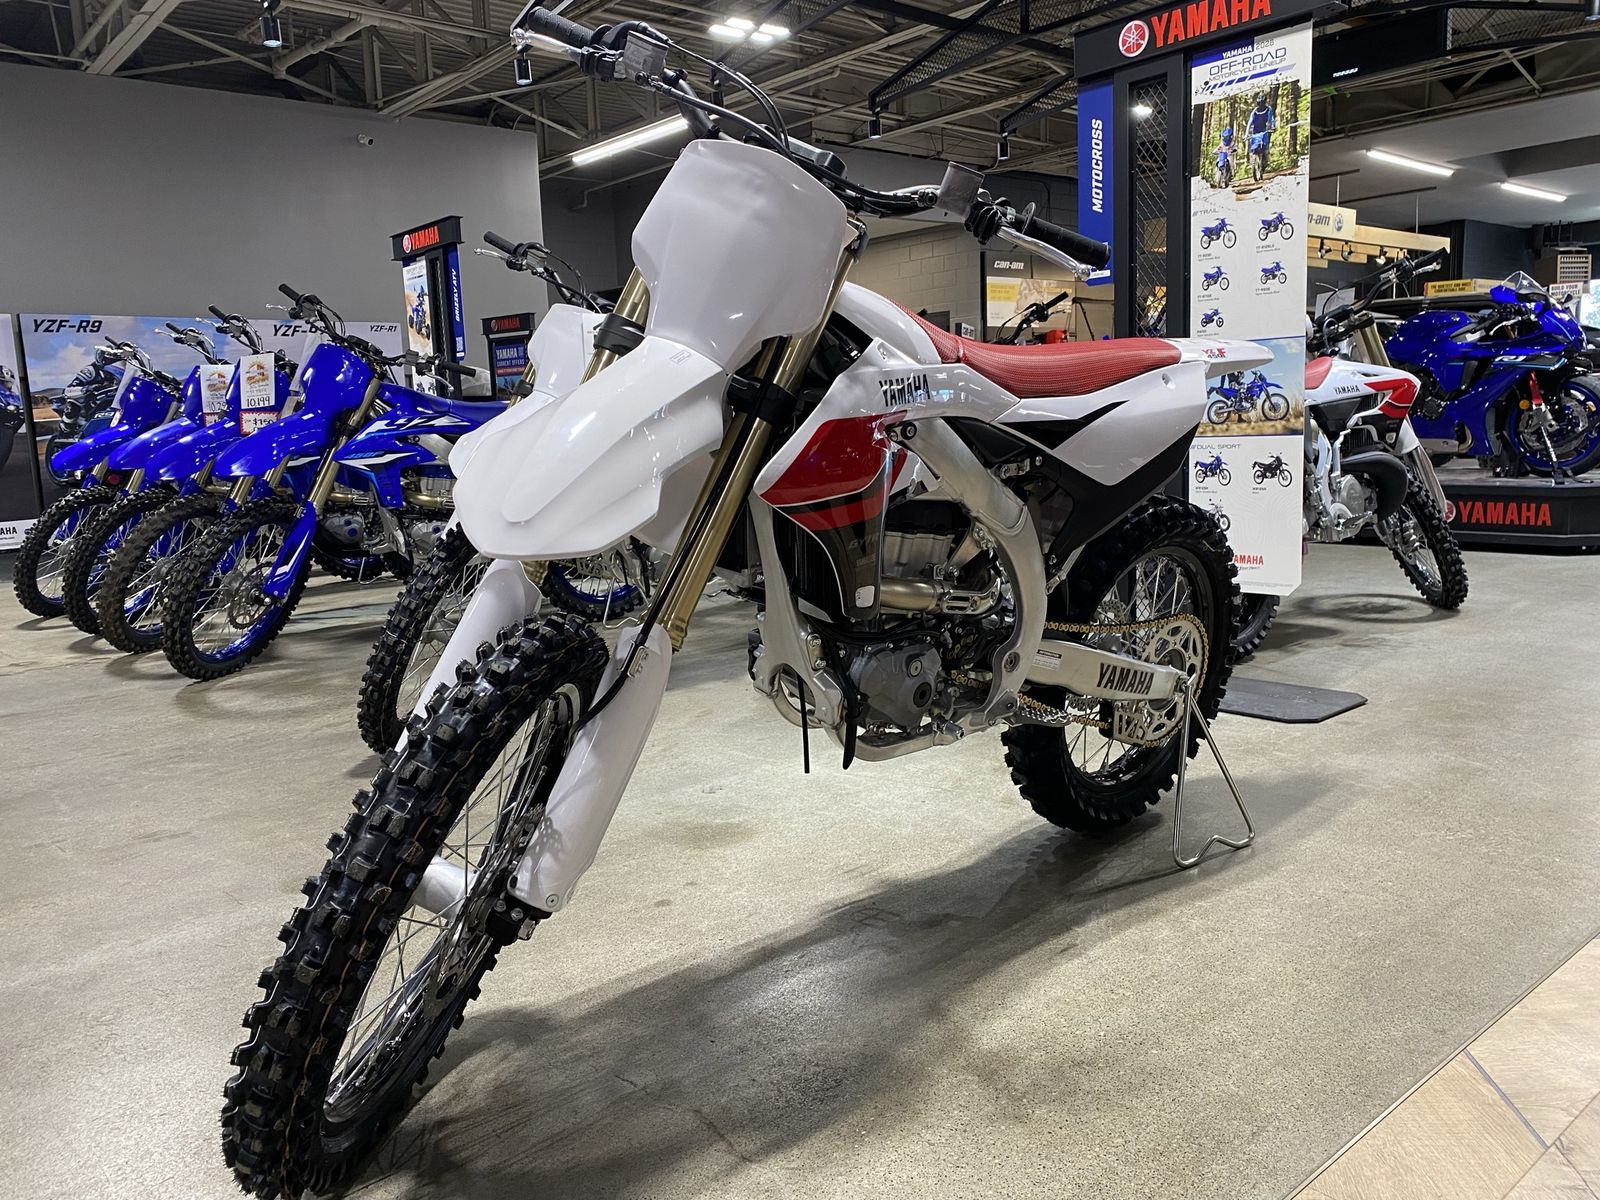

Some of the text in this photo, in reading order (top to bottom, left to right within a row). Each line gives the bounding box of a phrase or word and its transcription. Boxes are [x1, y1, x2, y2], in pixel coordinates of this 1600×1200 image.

[1151, 0, 1271, 47] YAMAHA
[1209, 47, 1287, 76] OFF-ROAD
[1222, 45, 1253, 59] YAMAHA
[1209, 57, 1287, 81] MOTORCYCLE LINEUP
[1091, 119, 1103, 213] MOTOCROSS
[410, 225, 440, 250] YAMAHA
[994, 260, 1025, 270] can-am
[33, 319, 103, 333] YZF-R9
[497, 316, 521, 331] YAMAHA
[496, 347, 518, 360] YAMAHA
[879, 374, 931, 407] YAMAHA
[1334, 385, 1361, 395] YAMAHA
[1458, 501, 1552, 526] YAMAHA
[1234, 554, 1264, 566] AMAHA
[1097, 662, 1155, 695] YAMAHA
